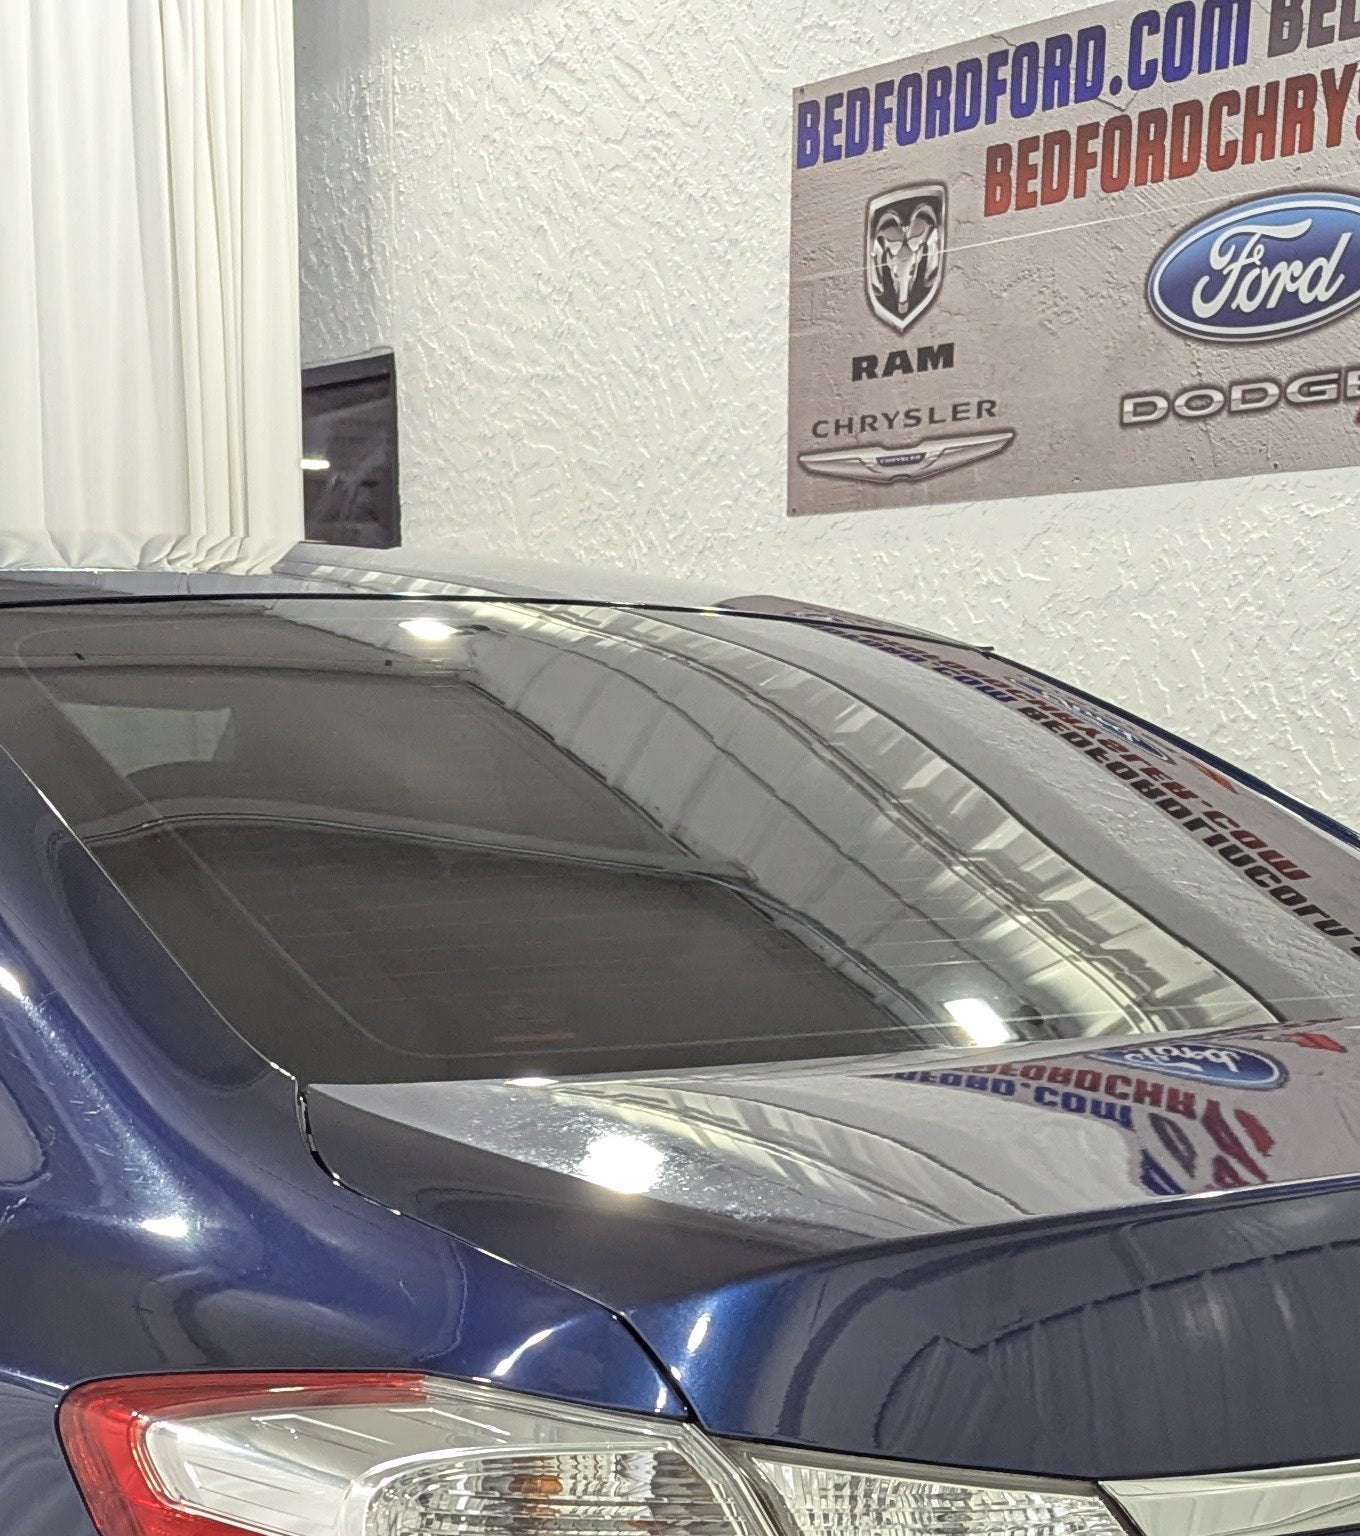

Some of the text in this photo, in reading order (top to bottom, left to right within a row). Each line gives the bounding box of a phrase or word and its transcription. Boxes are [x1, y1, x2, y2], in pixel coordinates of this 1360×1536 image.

[796, 0, 1252, 169] BEDFORDFORD.COM
[1191, 216, 1352, 319] Ford
[851, 342, 955, 382] RAM
[811, 399, 998, 439] CHRYSLER
